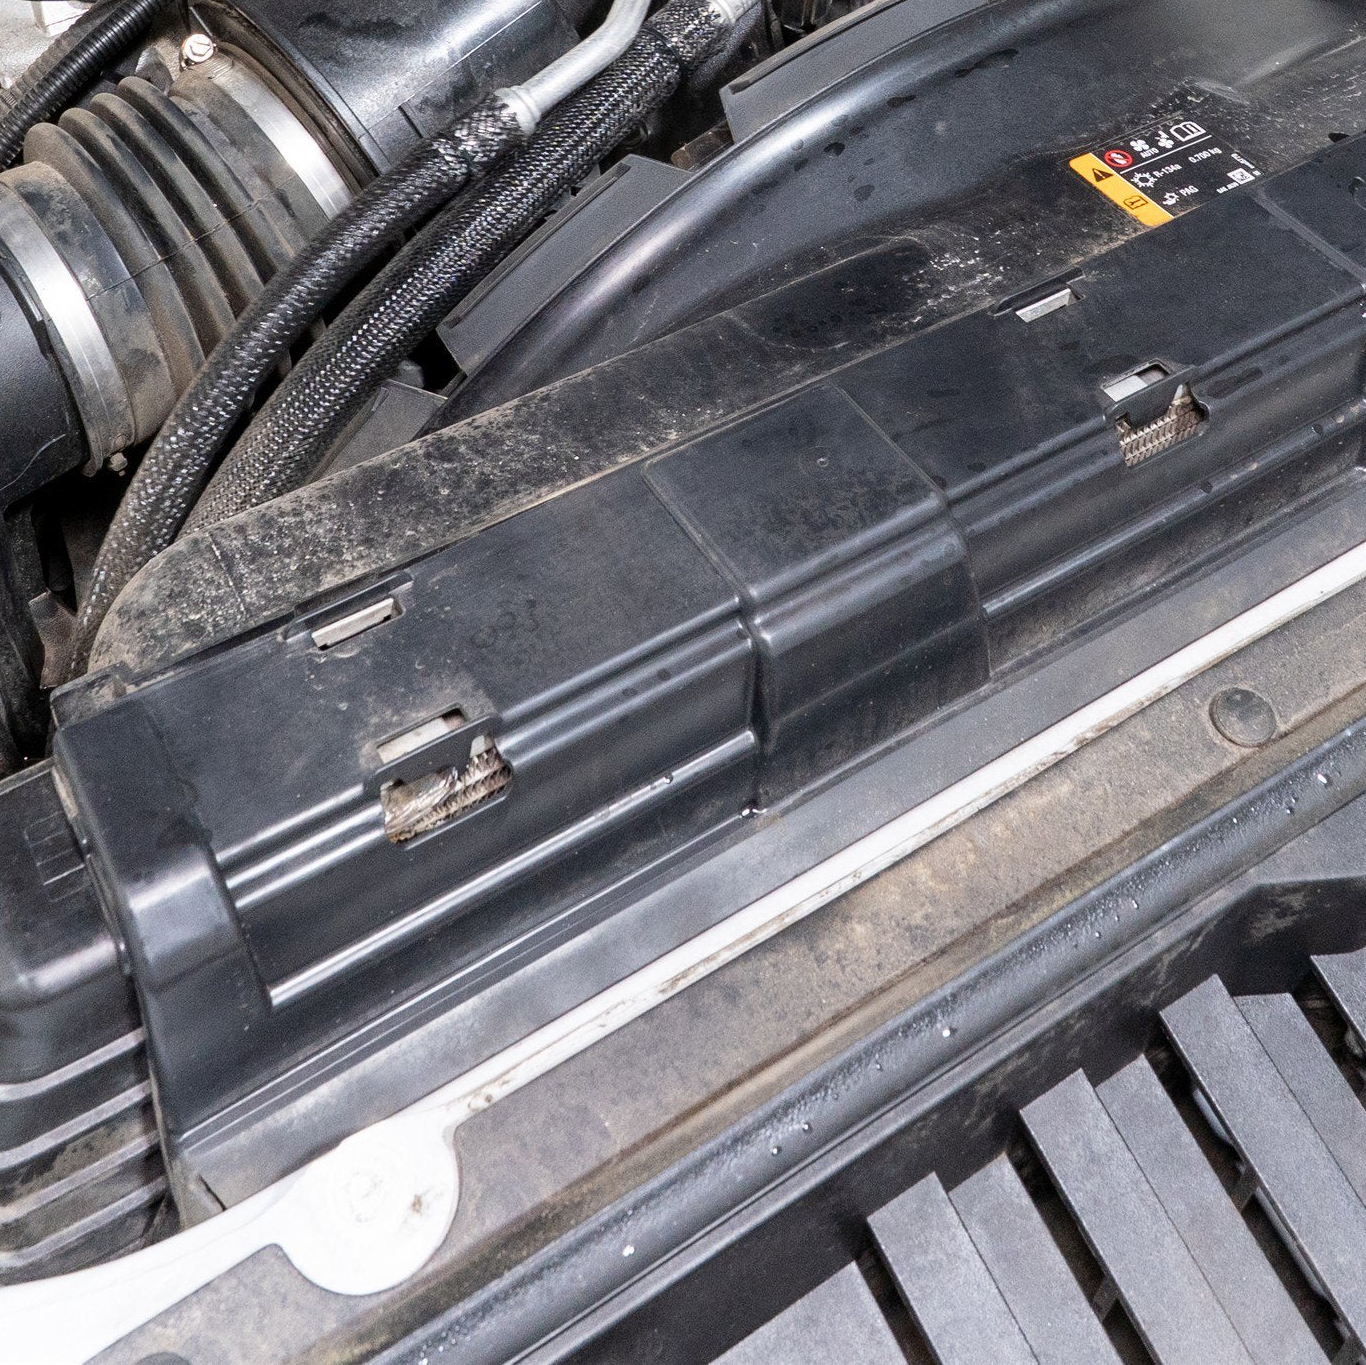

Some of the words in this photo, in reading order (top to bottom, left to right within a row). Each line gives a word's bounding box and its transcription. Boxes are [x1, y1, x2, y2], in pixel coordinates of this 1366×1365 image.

[1140, 147, 1160, 159] AUTO
[1152, 163, 1183, 179] R-134a
[1188, 150, 1212, 164] 0.700
[1208, 147, 1223, 156] kg
[1179, 185, 1199, 197] PAG
